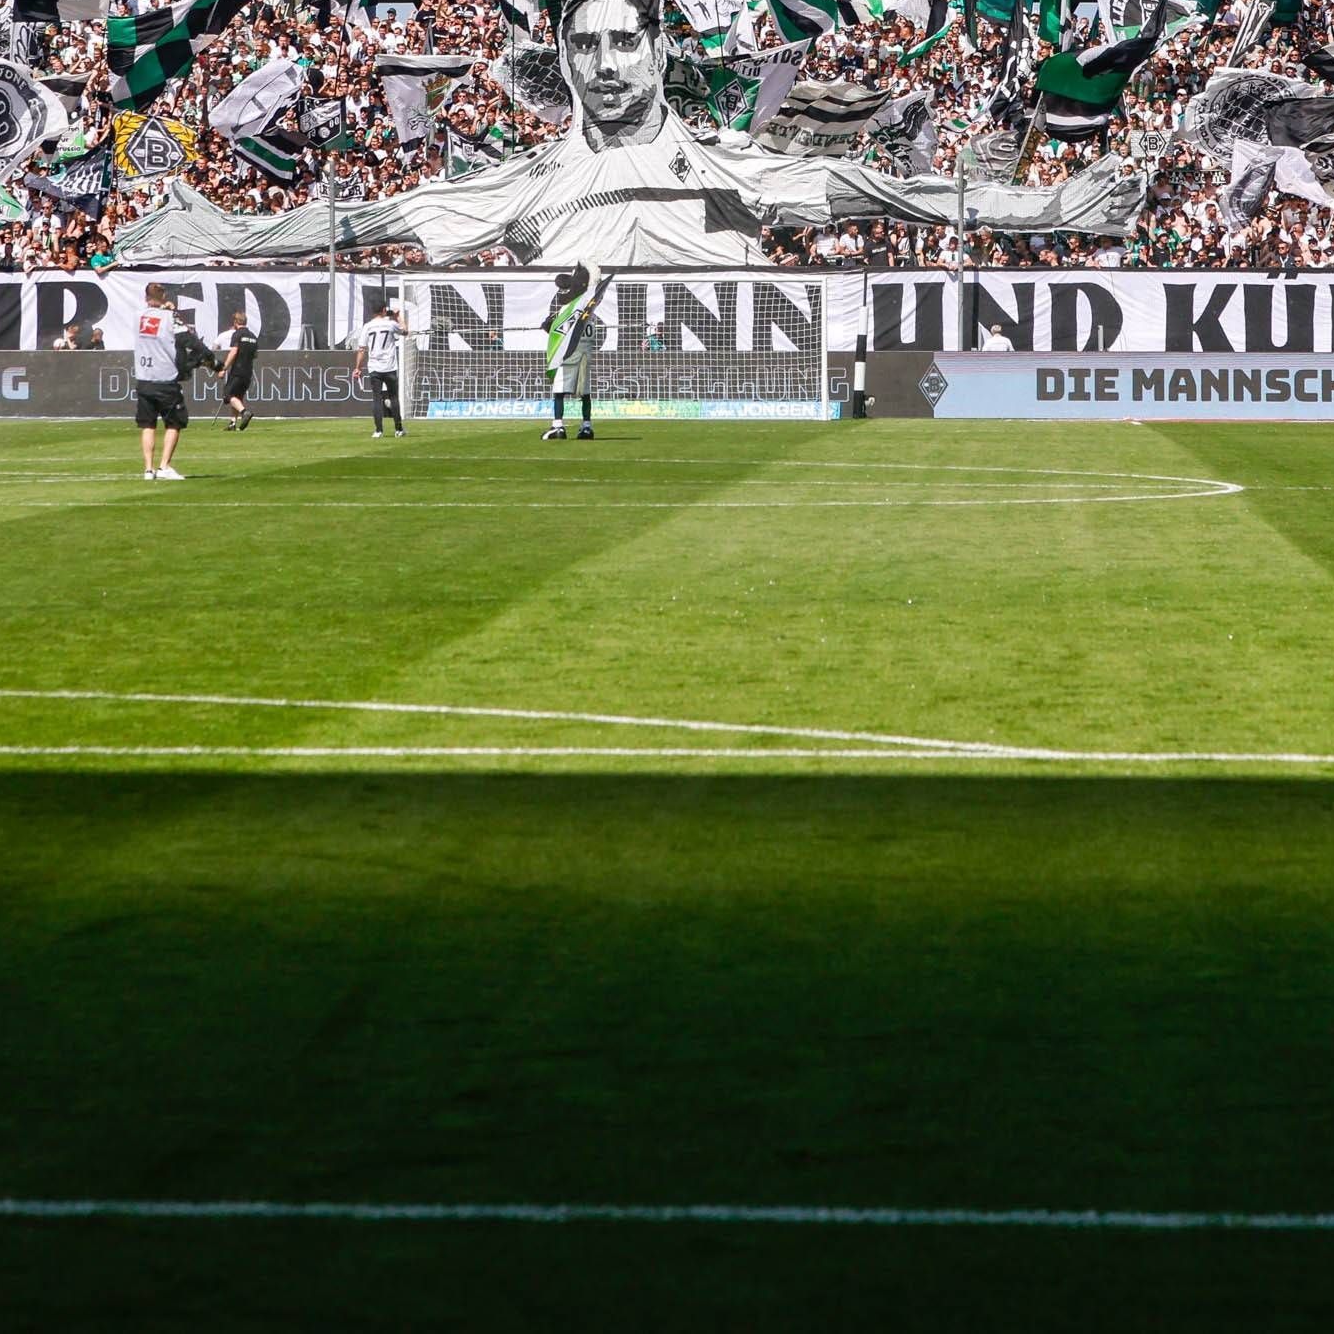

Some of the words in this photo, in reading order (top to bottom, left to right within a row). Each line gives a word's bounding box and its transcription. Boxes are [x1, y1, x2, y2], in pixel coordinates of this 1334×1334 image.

[871, 282, 1125, 353] UND
[367, 330, 390, 351] 77
[1035, 368, 1121, 402] DIE
[463, 402, 536, 416] JONGEN
